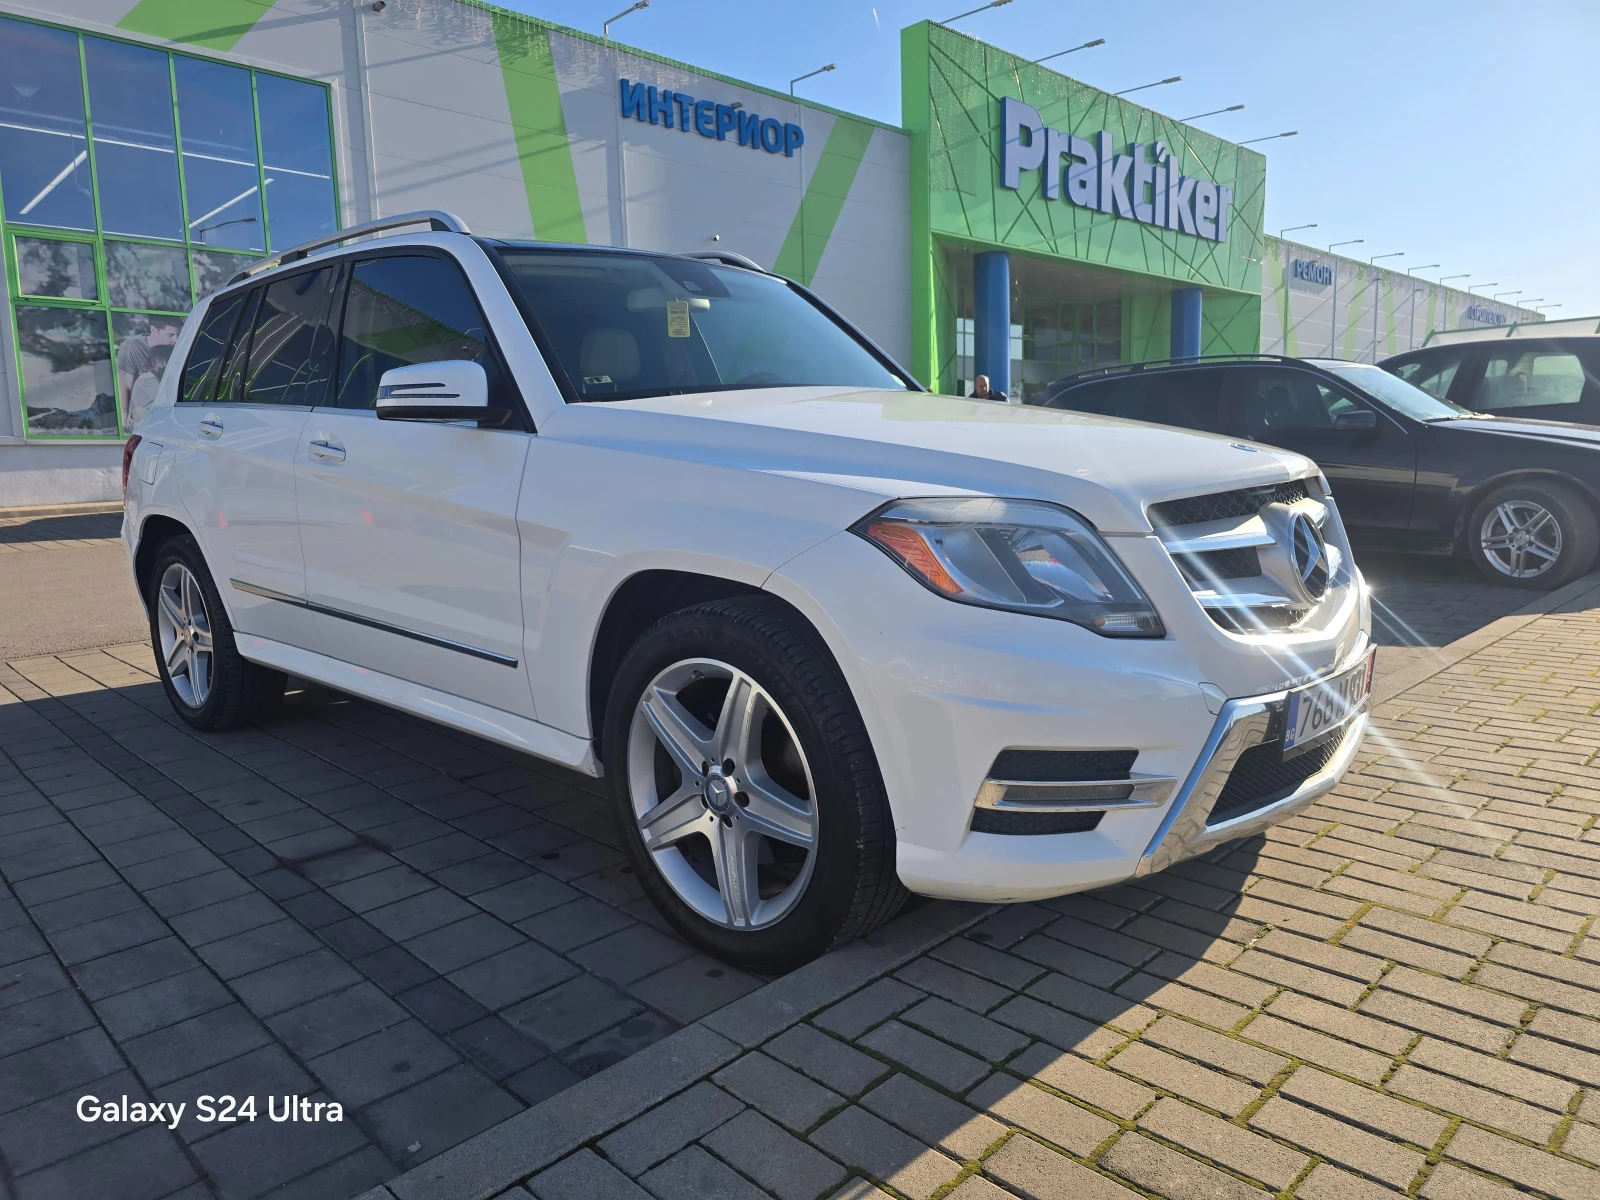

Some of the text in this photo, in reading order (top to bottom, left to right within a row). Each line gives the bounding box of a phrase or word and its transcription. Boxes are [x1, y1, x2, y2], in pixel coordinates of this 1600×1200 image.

[620, 78, 804, 157] ИНТЕРИОР
[1000, 96, 1234, 243] Praktiker
[1295, 258, 1336, 286] РЕМОНТ
